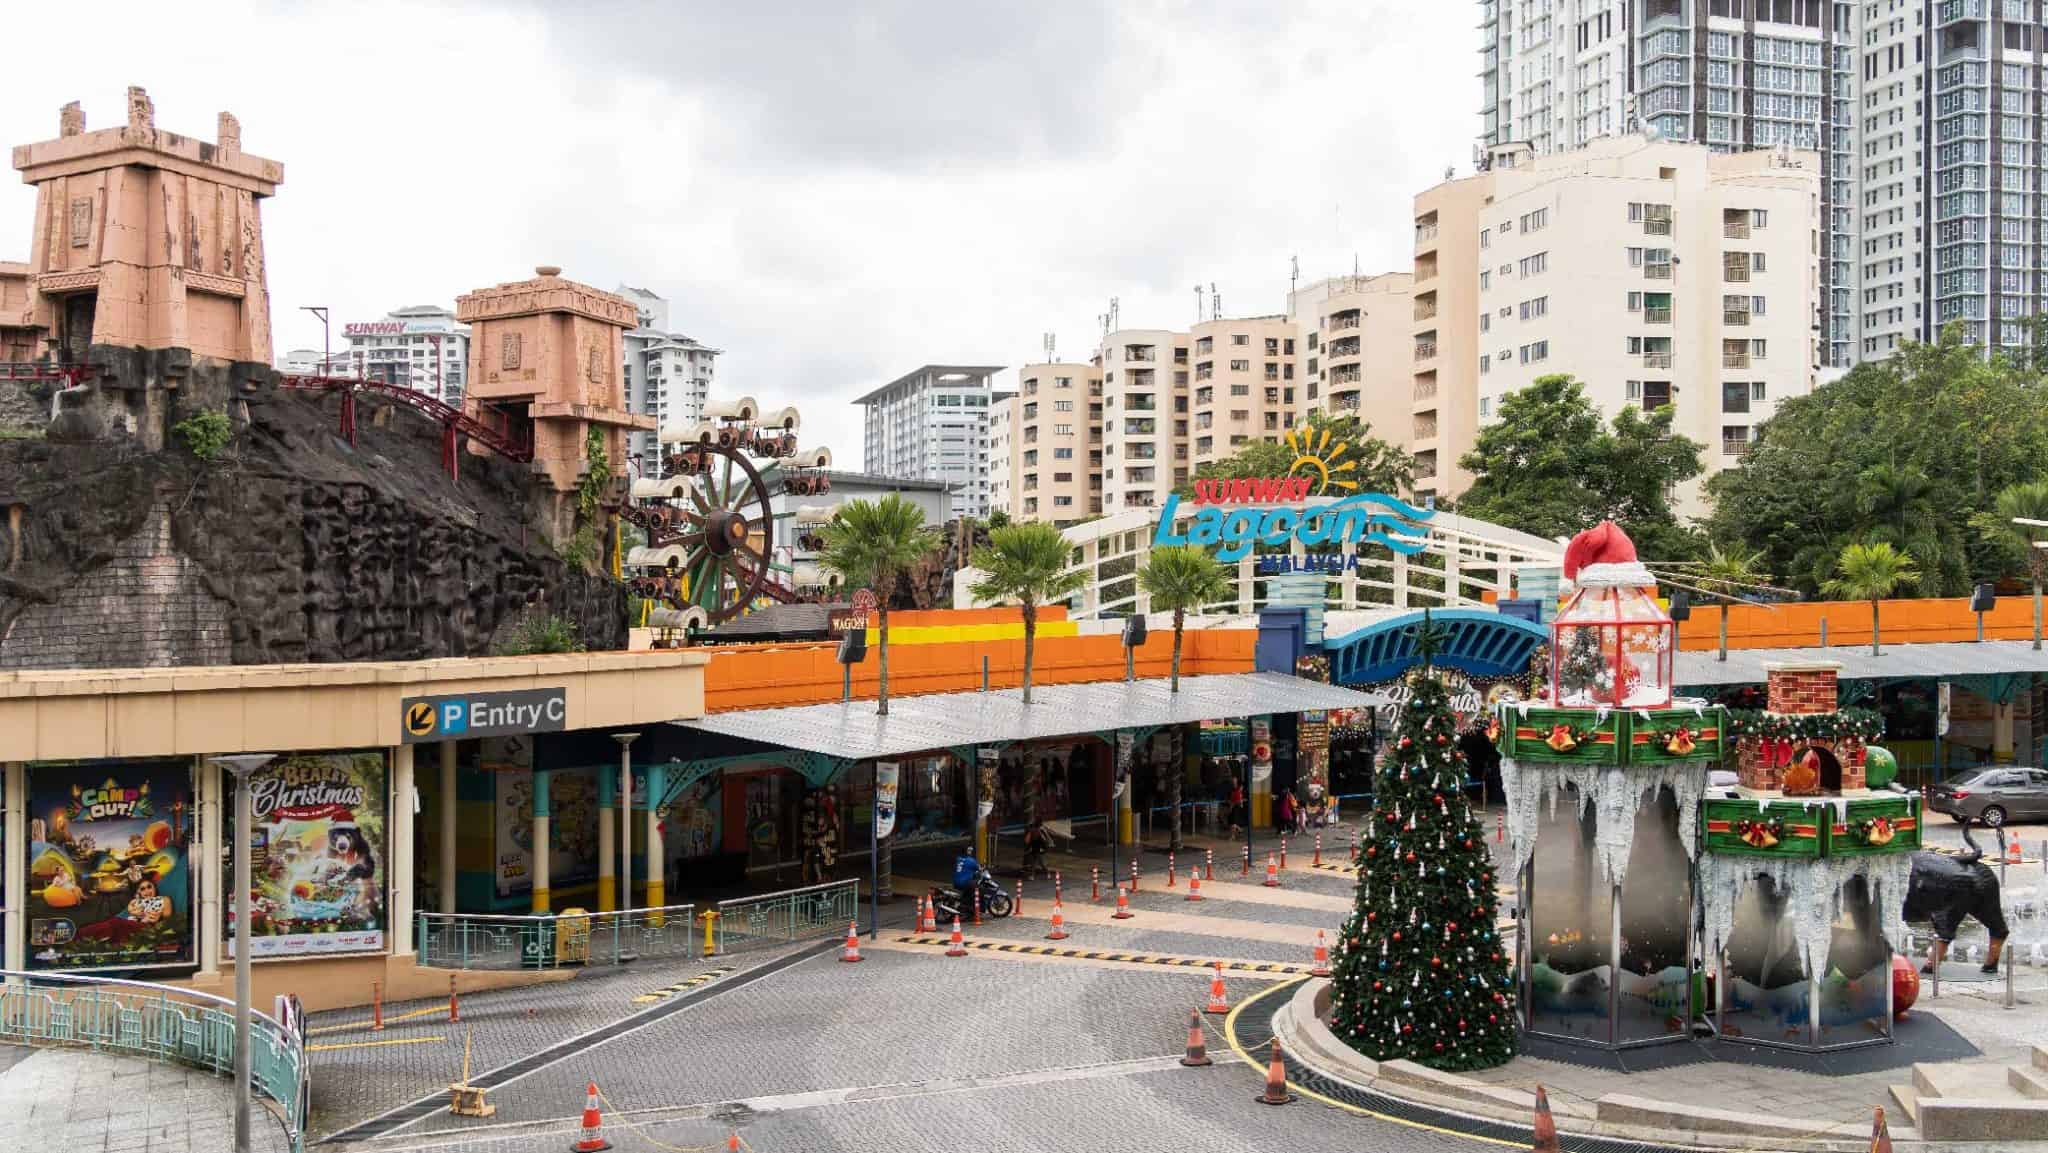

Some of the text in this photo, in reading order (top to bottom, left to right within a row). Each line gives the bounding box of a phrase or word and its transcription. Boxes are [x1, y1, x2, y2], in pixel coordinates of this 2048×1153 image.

[345, 321, 407, 334] SUNWAY
[1194, 477, 1314, 505] SUNWAY
[1153, 494, 1368, 562] Lagoon
[1260, 554, 1359, 573] MALAYSIA
[444, 697, 564, 729] P Entry C
[81, 788, 139, 806] CAMP
[250, 778, 363, 817] Christmas
[90, 800, 137, 818] OUT!
